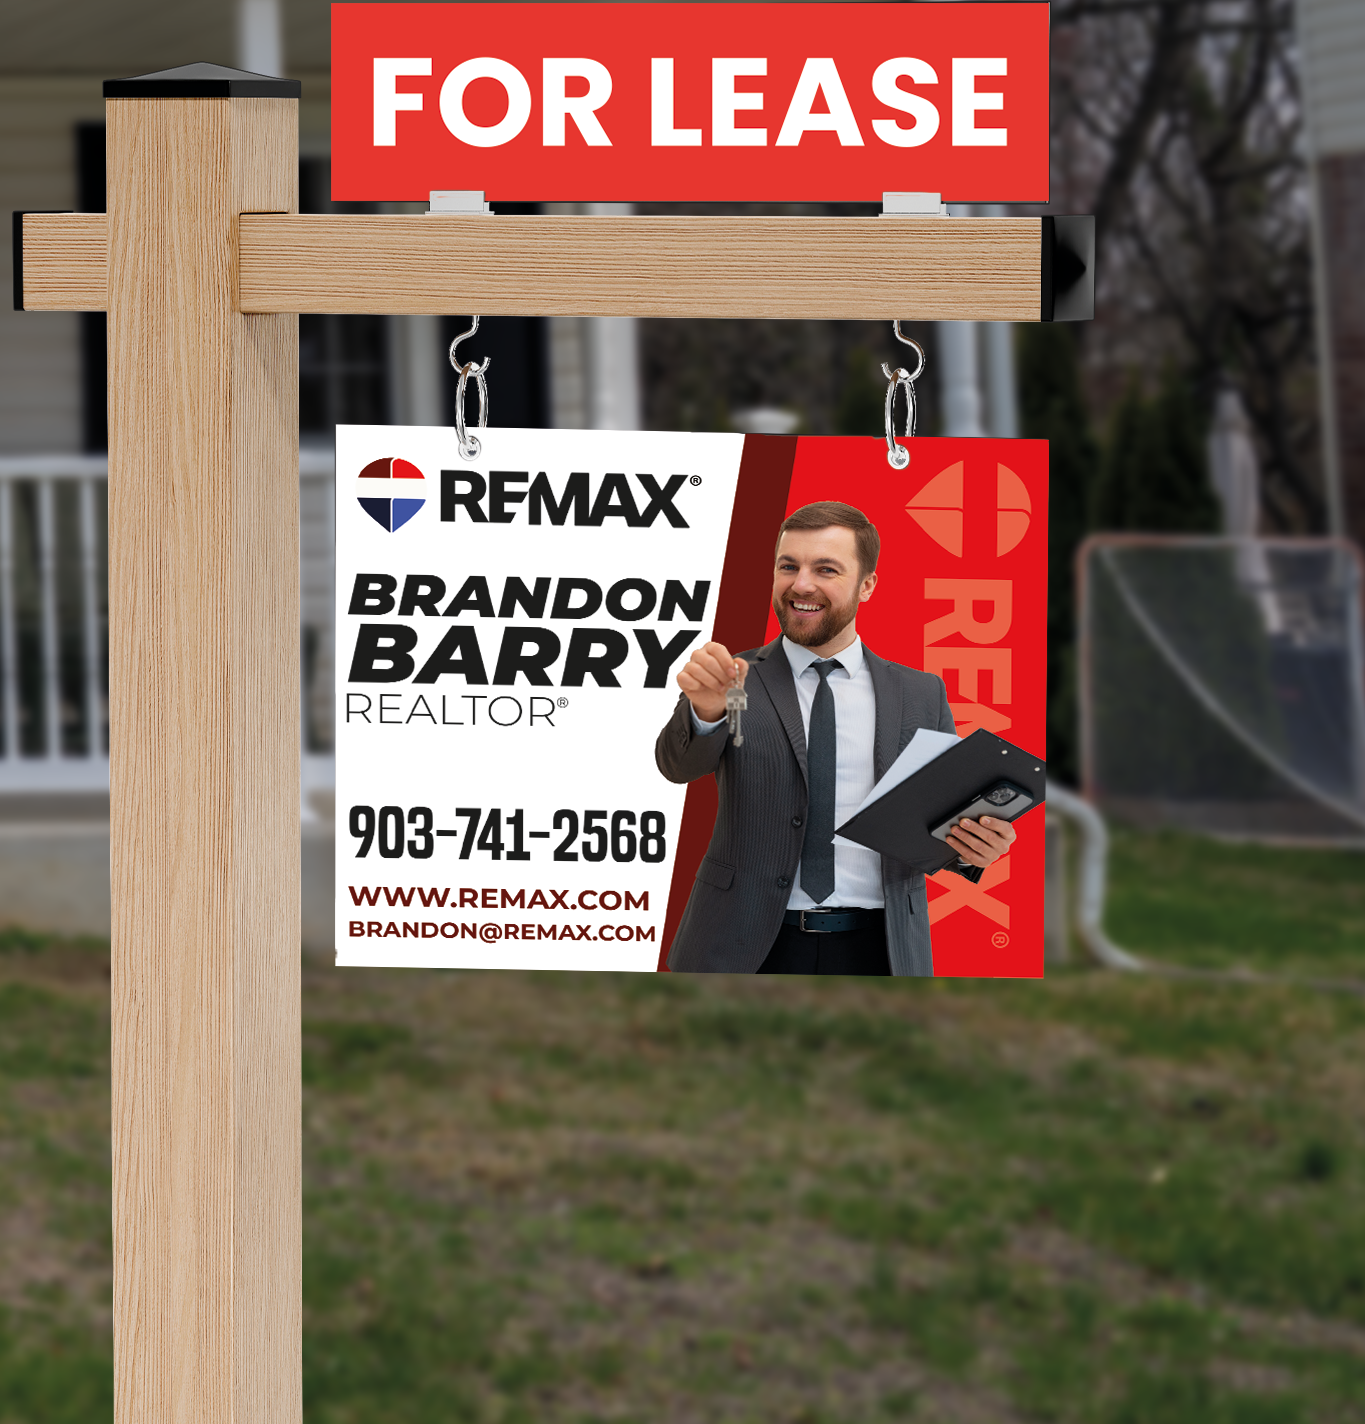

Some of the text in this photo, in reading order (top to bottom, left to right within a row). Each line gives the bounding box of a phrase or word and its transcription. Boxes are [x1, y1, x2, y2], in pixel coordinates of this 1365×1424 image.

[373, 56, 1008, 148] FOR LEASE
[347, 573, 712, 622] BRANDON
[347, 623, 703, 689] BARRY
[348, 805, 667, 864] 903-741-2568
[347, 885, 650, 912] WWW.REMAX.COM
[348, 920, 656, 944] BRANDON@REMAX.COM
